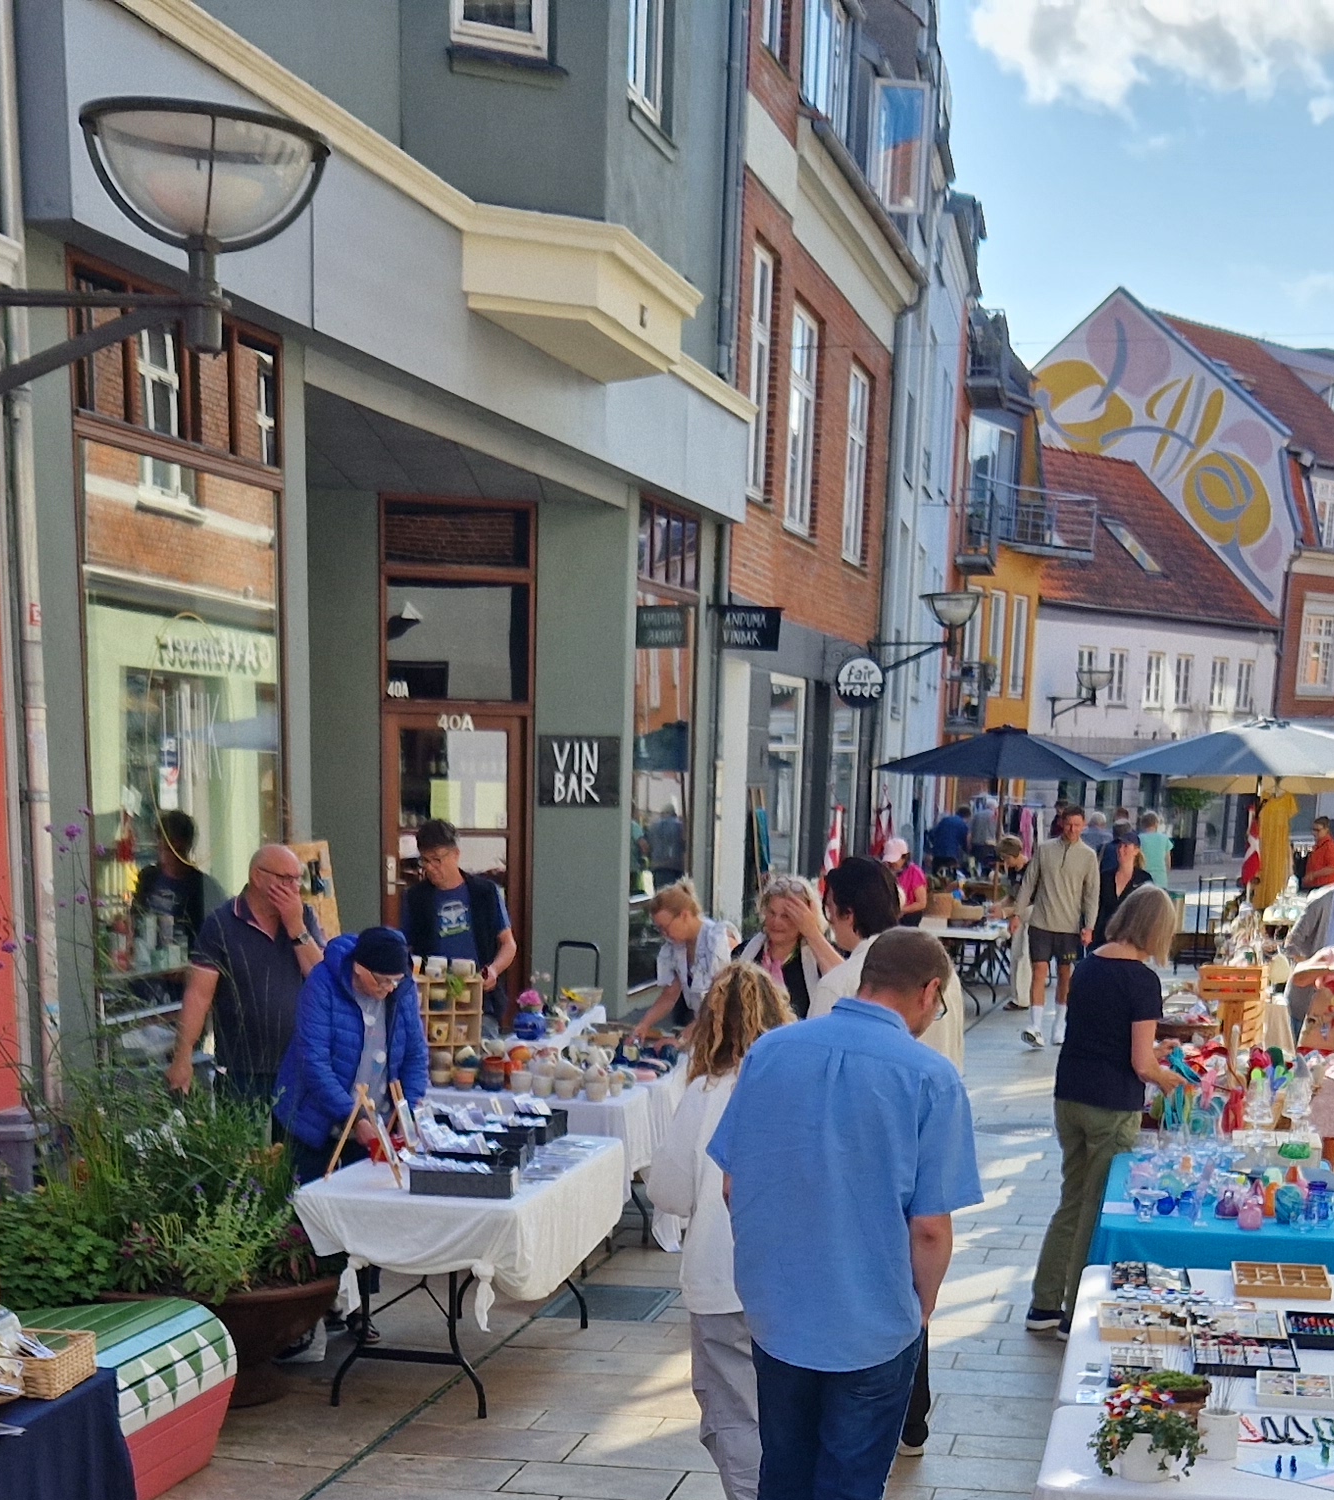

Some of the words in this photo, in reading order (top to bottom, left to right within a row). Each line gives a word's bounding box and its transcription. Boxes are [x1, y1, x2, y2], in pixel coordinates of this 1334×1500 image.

[847, 665, 875, 683] fair
[387, 681, 409, 698] 40A
[838, 682, 881, 698] trade
[437, 714, 474, 732] 40A
[552, 740, 599, 775] VIN
[553, 772, 600, 804] BAR
